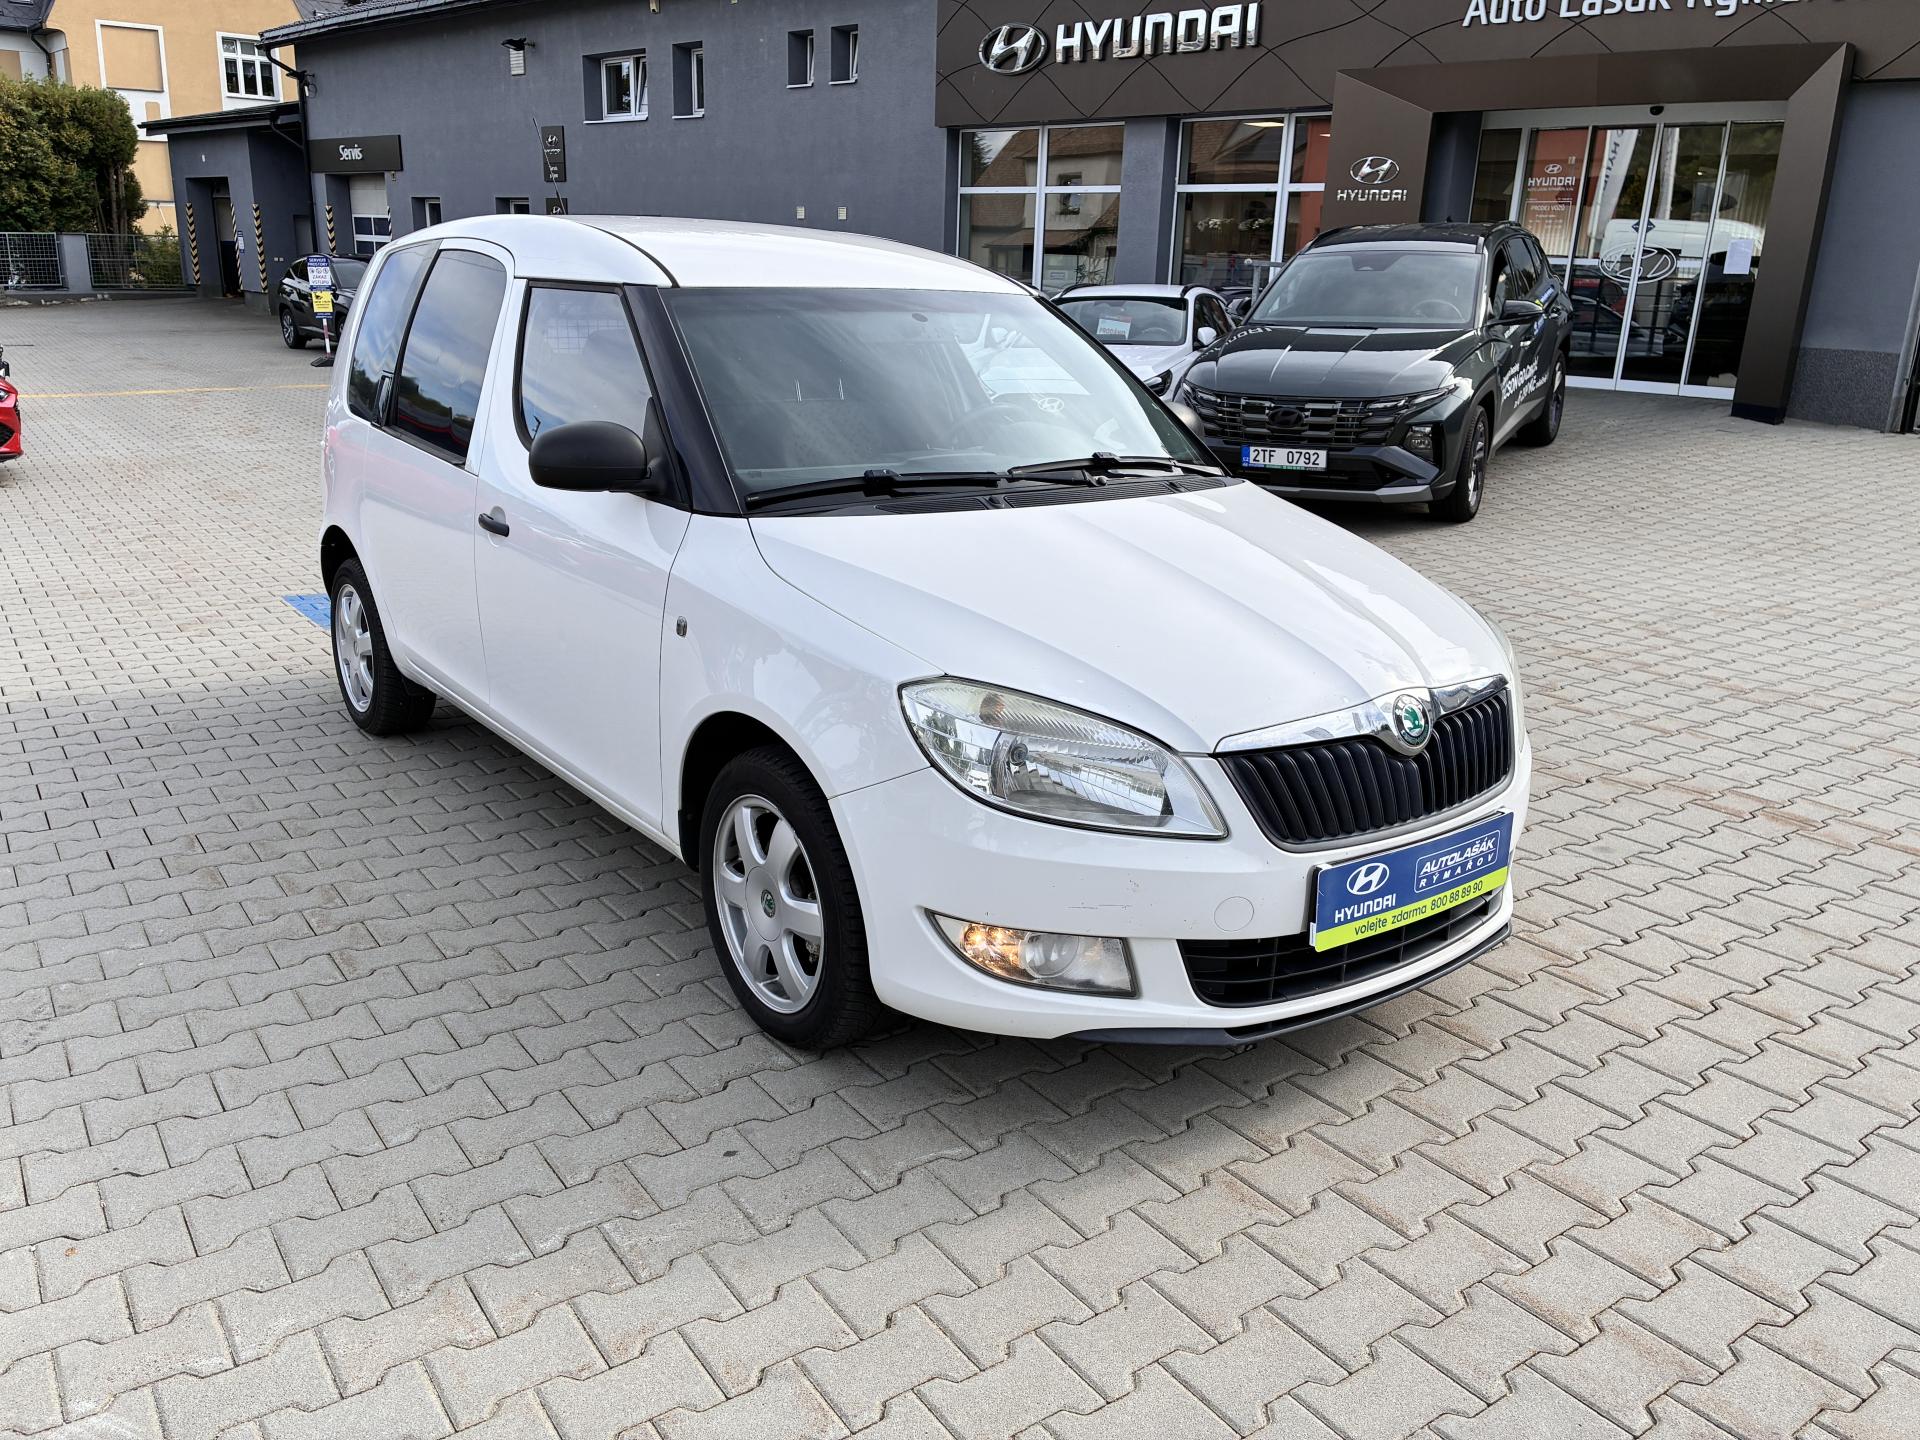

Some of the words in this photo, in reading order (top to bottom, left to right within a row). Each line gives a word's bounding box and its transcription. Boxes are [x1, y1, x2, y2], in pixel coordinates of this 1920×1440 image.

[1056, 2, 1260, 63] HYUNDAI
[339, 143, 363, 160] Servis
[1337, 189, 1407, 201] HYUNDAI
[1528, 176, 1576, 187] HYUNDAI
[1252, 449, 1276, 463] 2TF
[1286, 450, 1320, 466] 0792
[1419, 852, 1495, 888] RÝMAŘOV
[1420, 836, 1496, 875] AUTOLAŠÁK
[1334, 894, 1397, 923] HYUNDAI
[1354, 917, 1388, 936] volejte
[1391, 905, 1427, 925] zdarma
[1430, 896, 1447, 911] 800
[1449, 892, 1460, 906] 88
[1460, 887, 1472, 901] 89
[1472, 881, 1484, 896] 90
